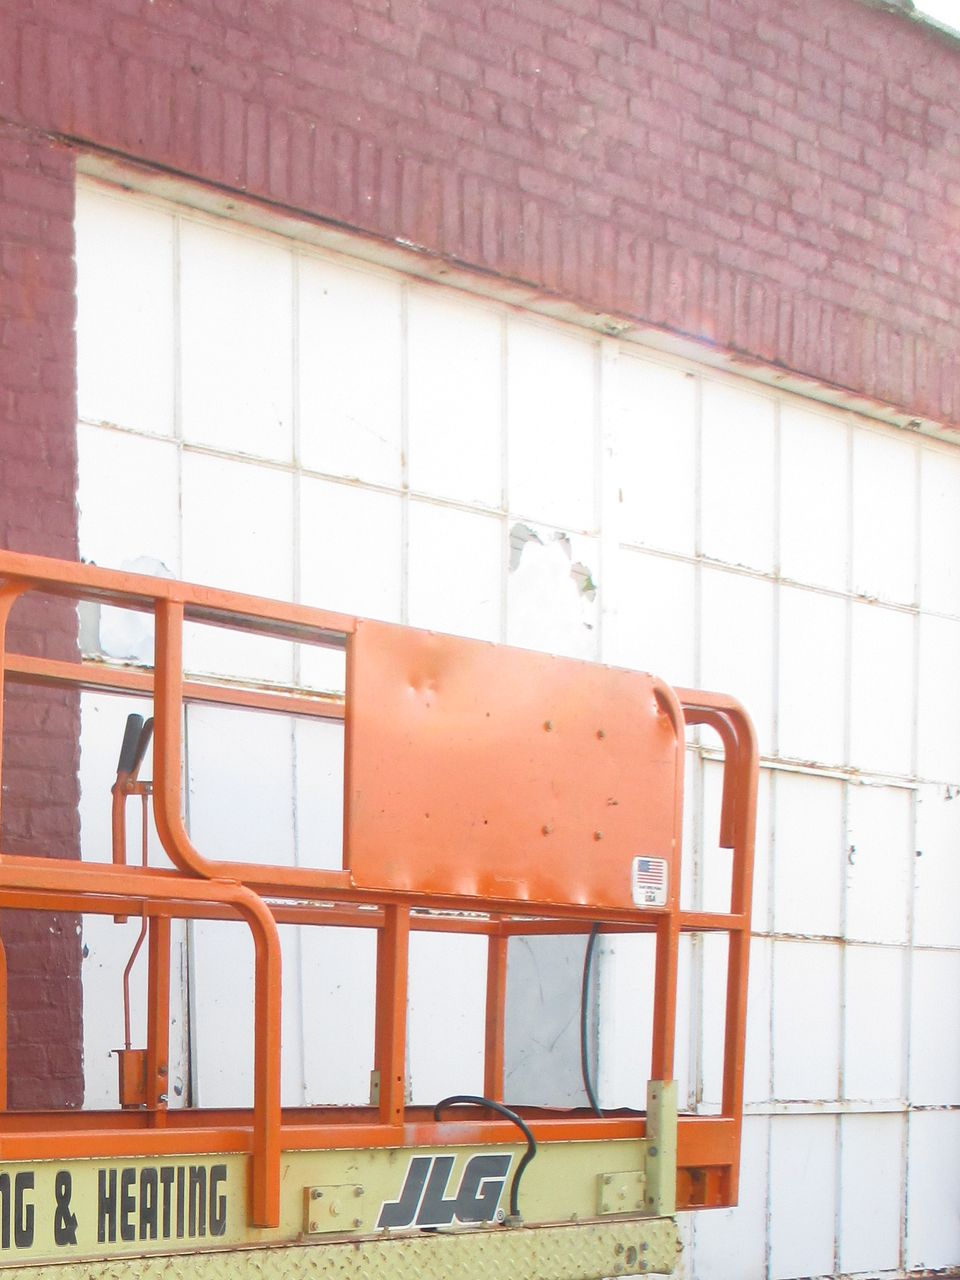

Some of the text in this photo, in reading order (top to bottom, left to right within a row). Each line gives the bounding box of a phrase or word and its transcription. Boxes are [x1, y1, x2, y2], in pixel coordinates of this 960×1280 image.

[54, 1170, 78, 1246] &
[97, 1164, 228, 1244] HEATING
[375, 1153, 514, 1231] JLG
